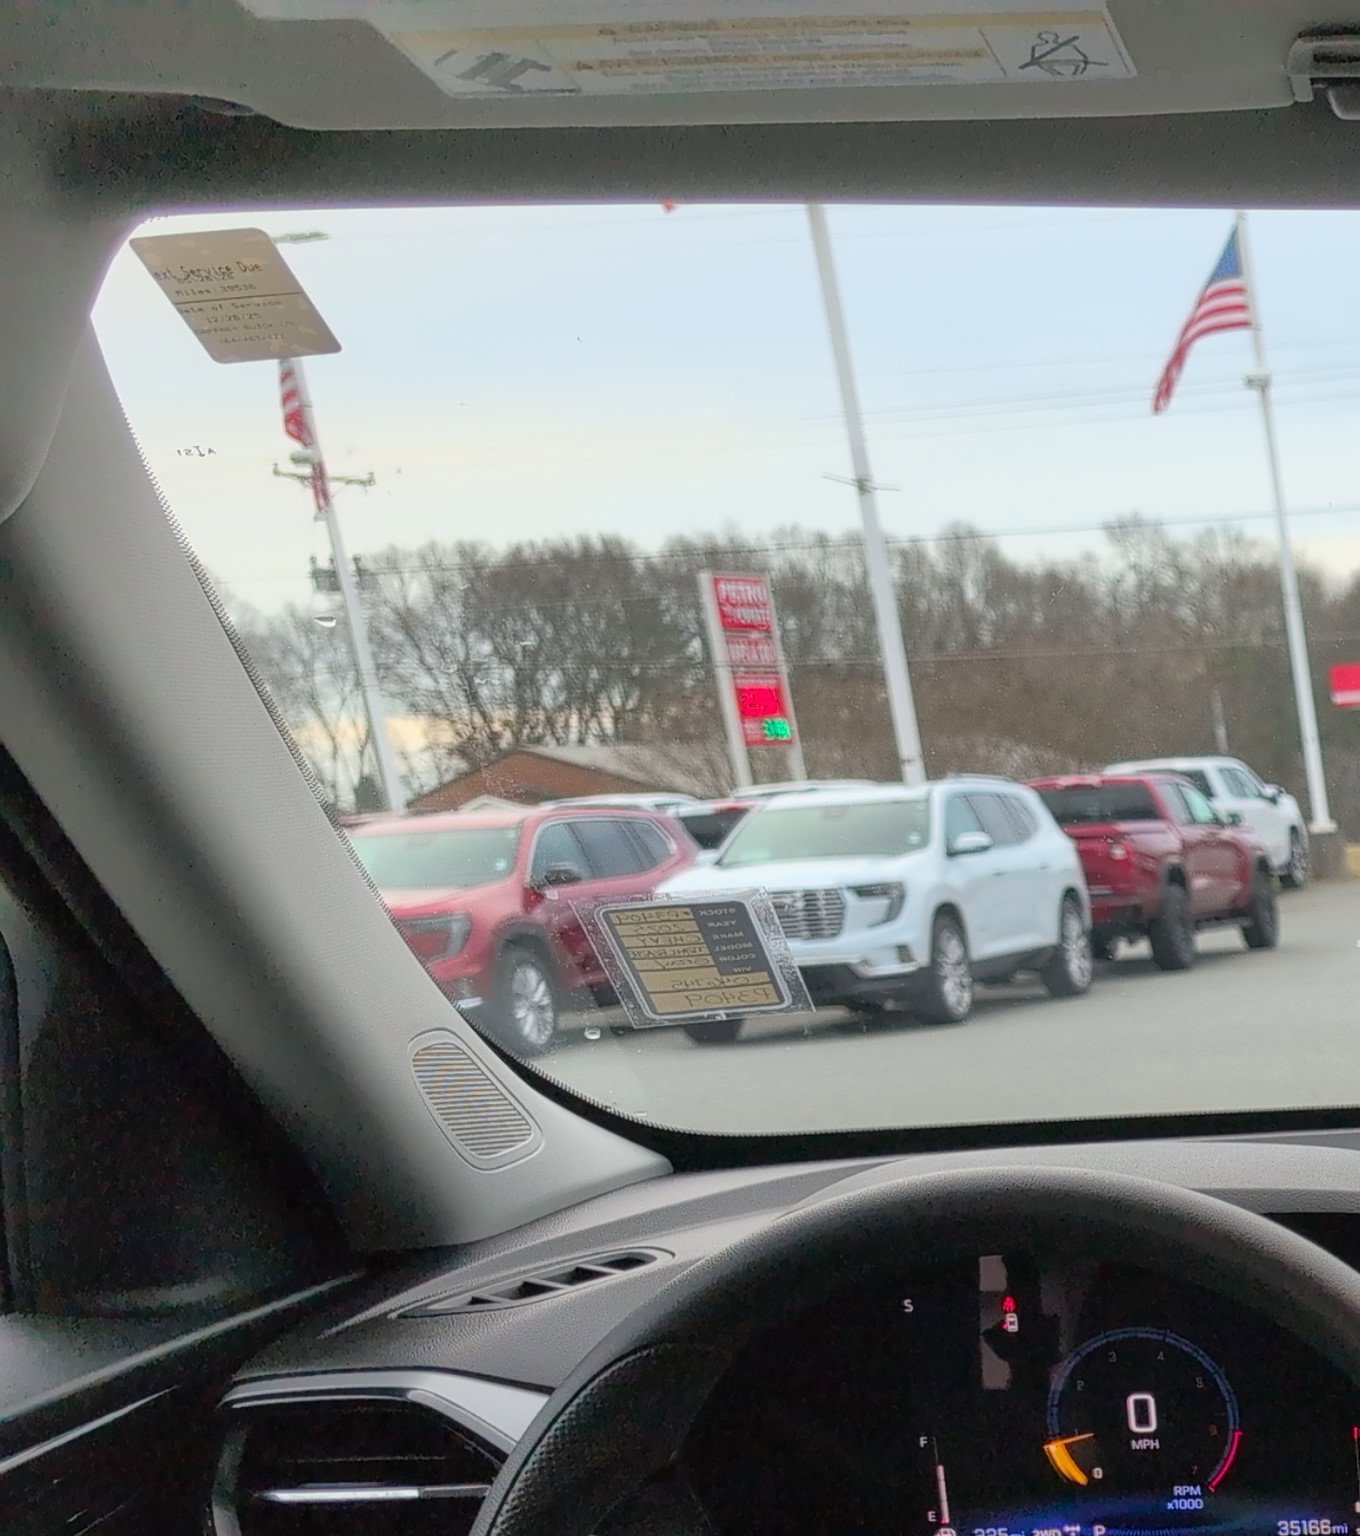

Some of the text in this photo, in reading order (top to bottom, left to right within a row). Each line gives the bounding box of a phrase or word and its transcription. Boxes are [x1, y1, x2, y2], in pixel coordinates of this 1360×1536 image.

[236, 260, 263, 273] Due
[904, 1299, 914, 1312] S
[1126, 1392, 1158, 1433] 0
[920, 1437, 928, 1447] F
[1131, 1439, 1160, 1450] MPH
[1173, 1485, 1202, 1496] RPM
[1167, 1500, 1204, 1510] x1000
[928, 1511, 936, 1522] E
